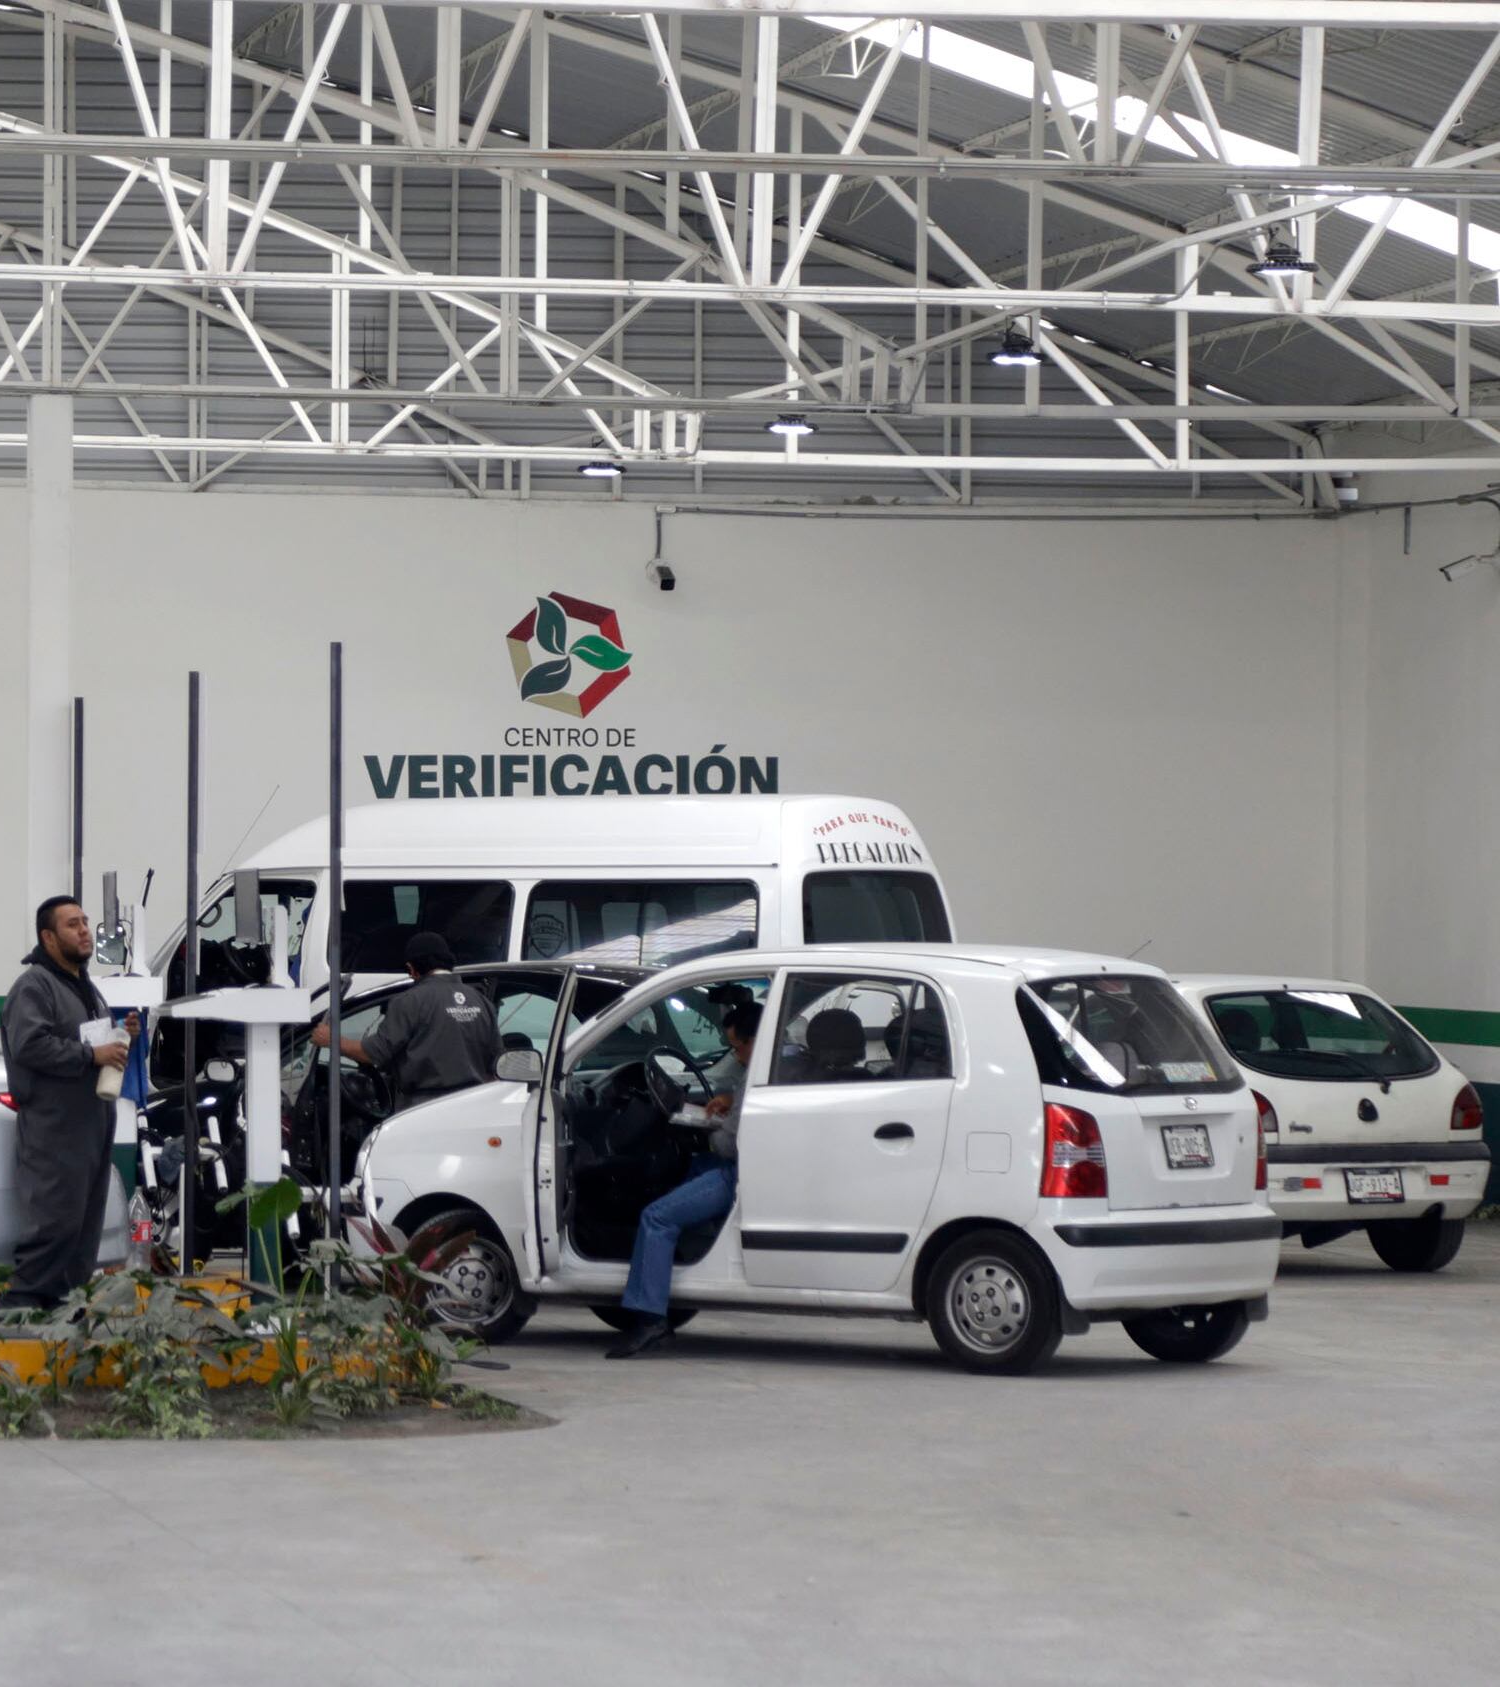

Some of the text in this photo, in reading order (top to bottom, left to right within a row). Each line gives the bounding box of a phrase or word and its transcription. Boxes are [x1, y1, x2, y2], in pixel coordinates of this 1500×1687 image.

[504, 727, 636, 747] CENTRO DE
[363, 744, 779, 798] VERIFICACIÓN
[848, 812, 869, 823] QUE
